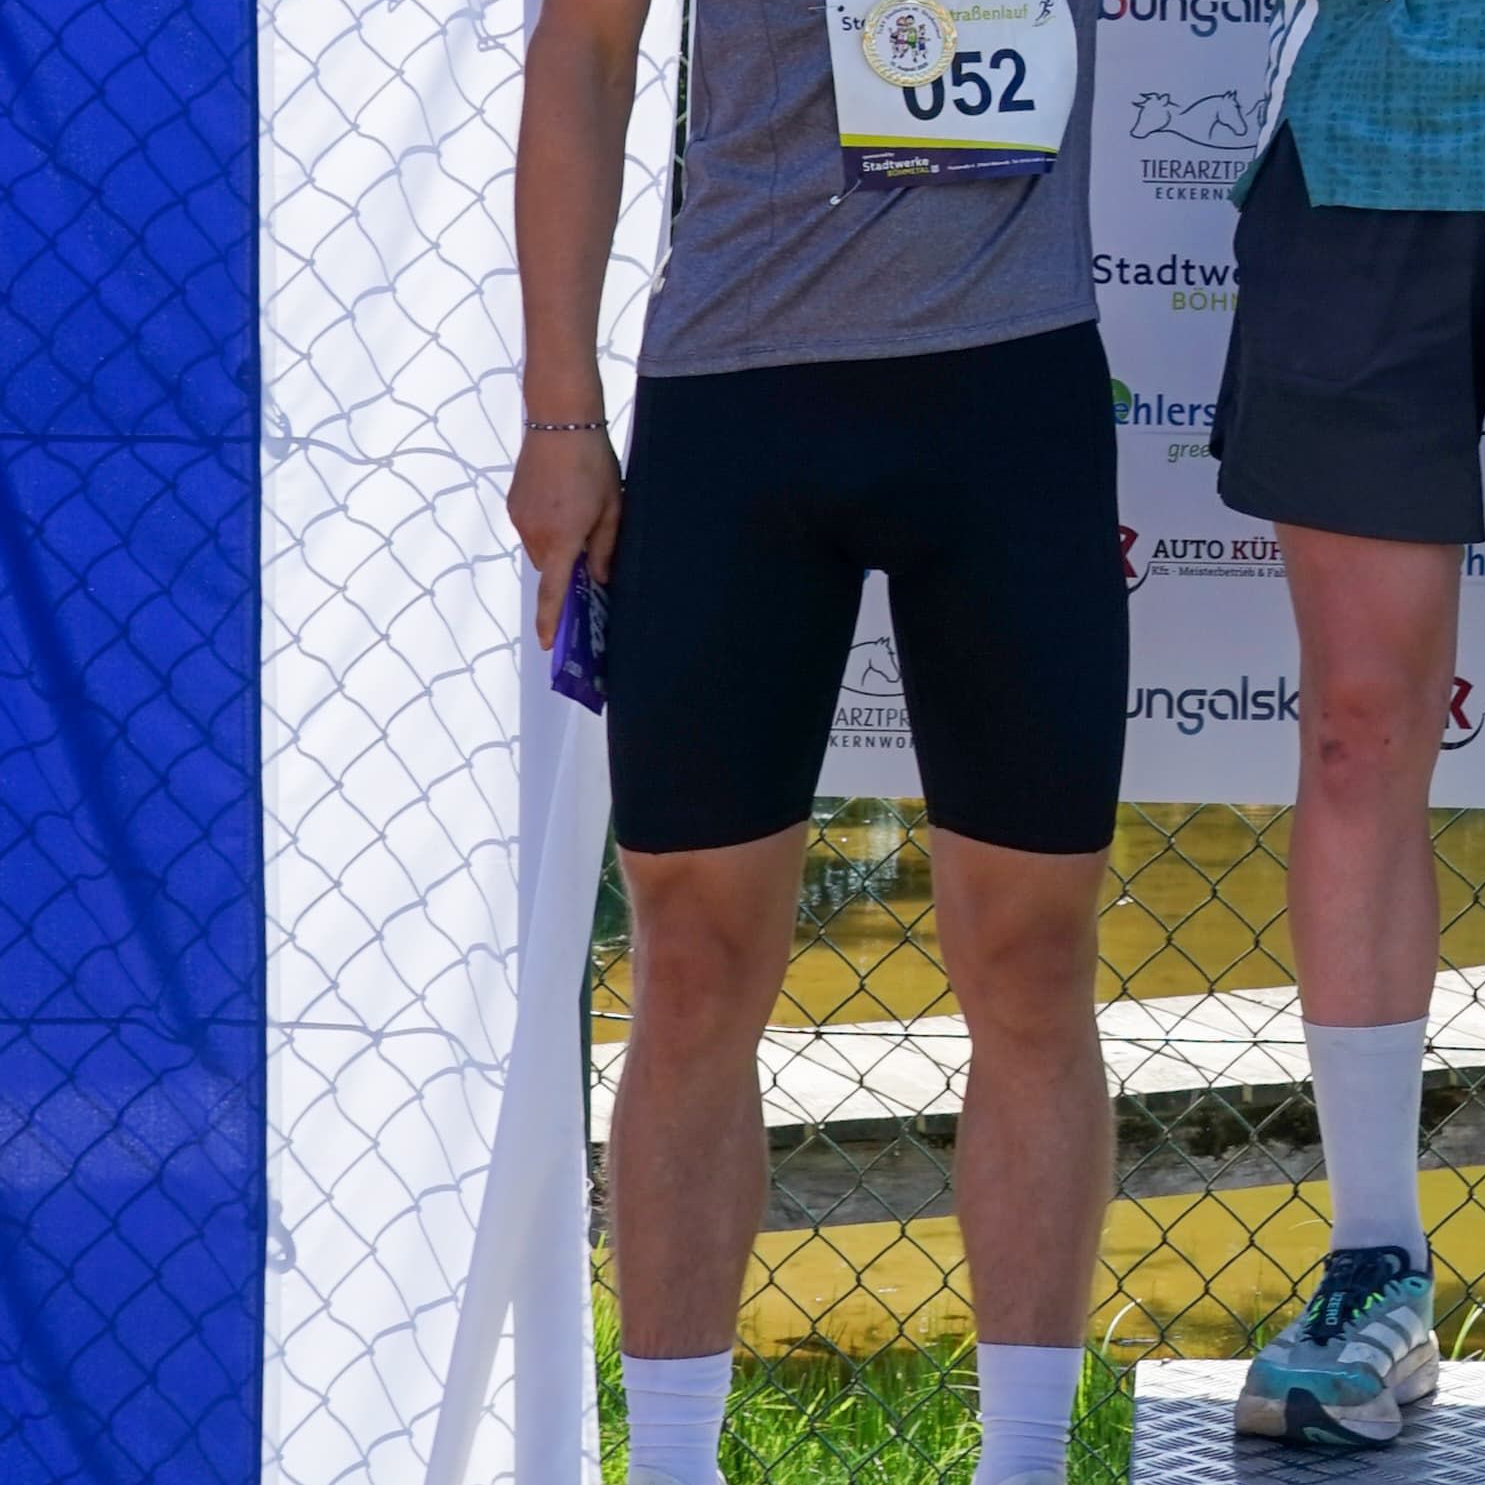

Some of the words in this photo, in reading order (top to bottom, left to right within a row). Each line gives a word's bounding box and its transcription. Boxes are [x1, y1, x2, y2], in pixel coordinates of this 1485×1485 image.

[947, 3, 1029, 22] traßenlauf
[862, 156, 930, 173] Stadtwerke
[1152, 539, 1224, 560] AUTO
